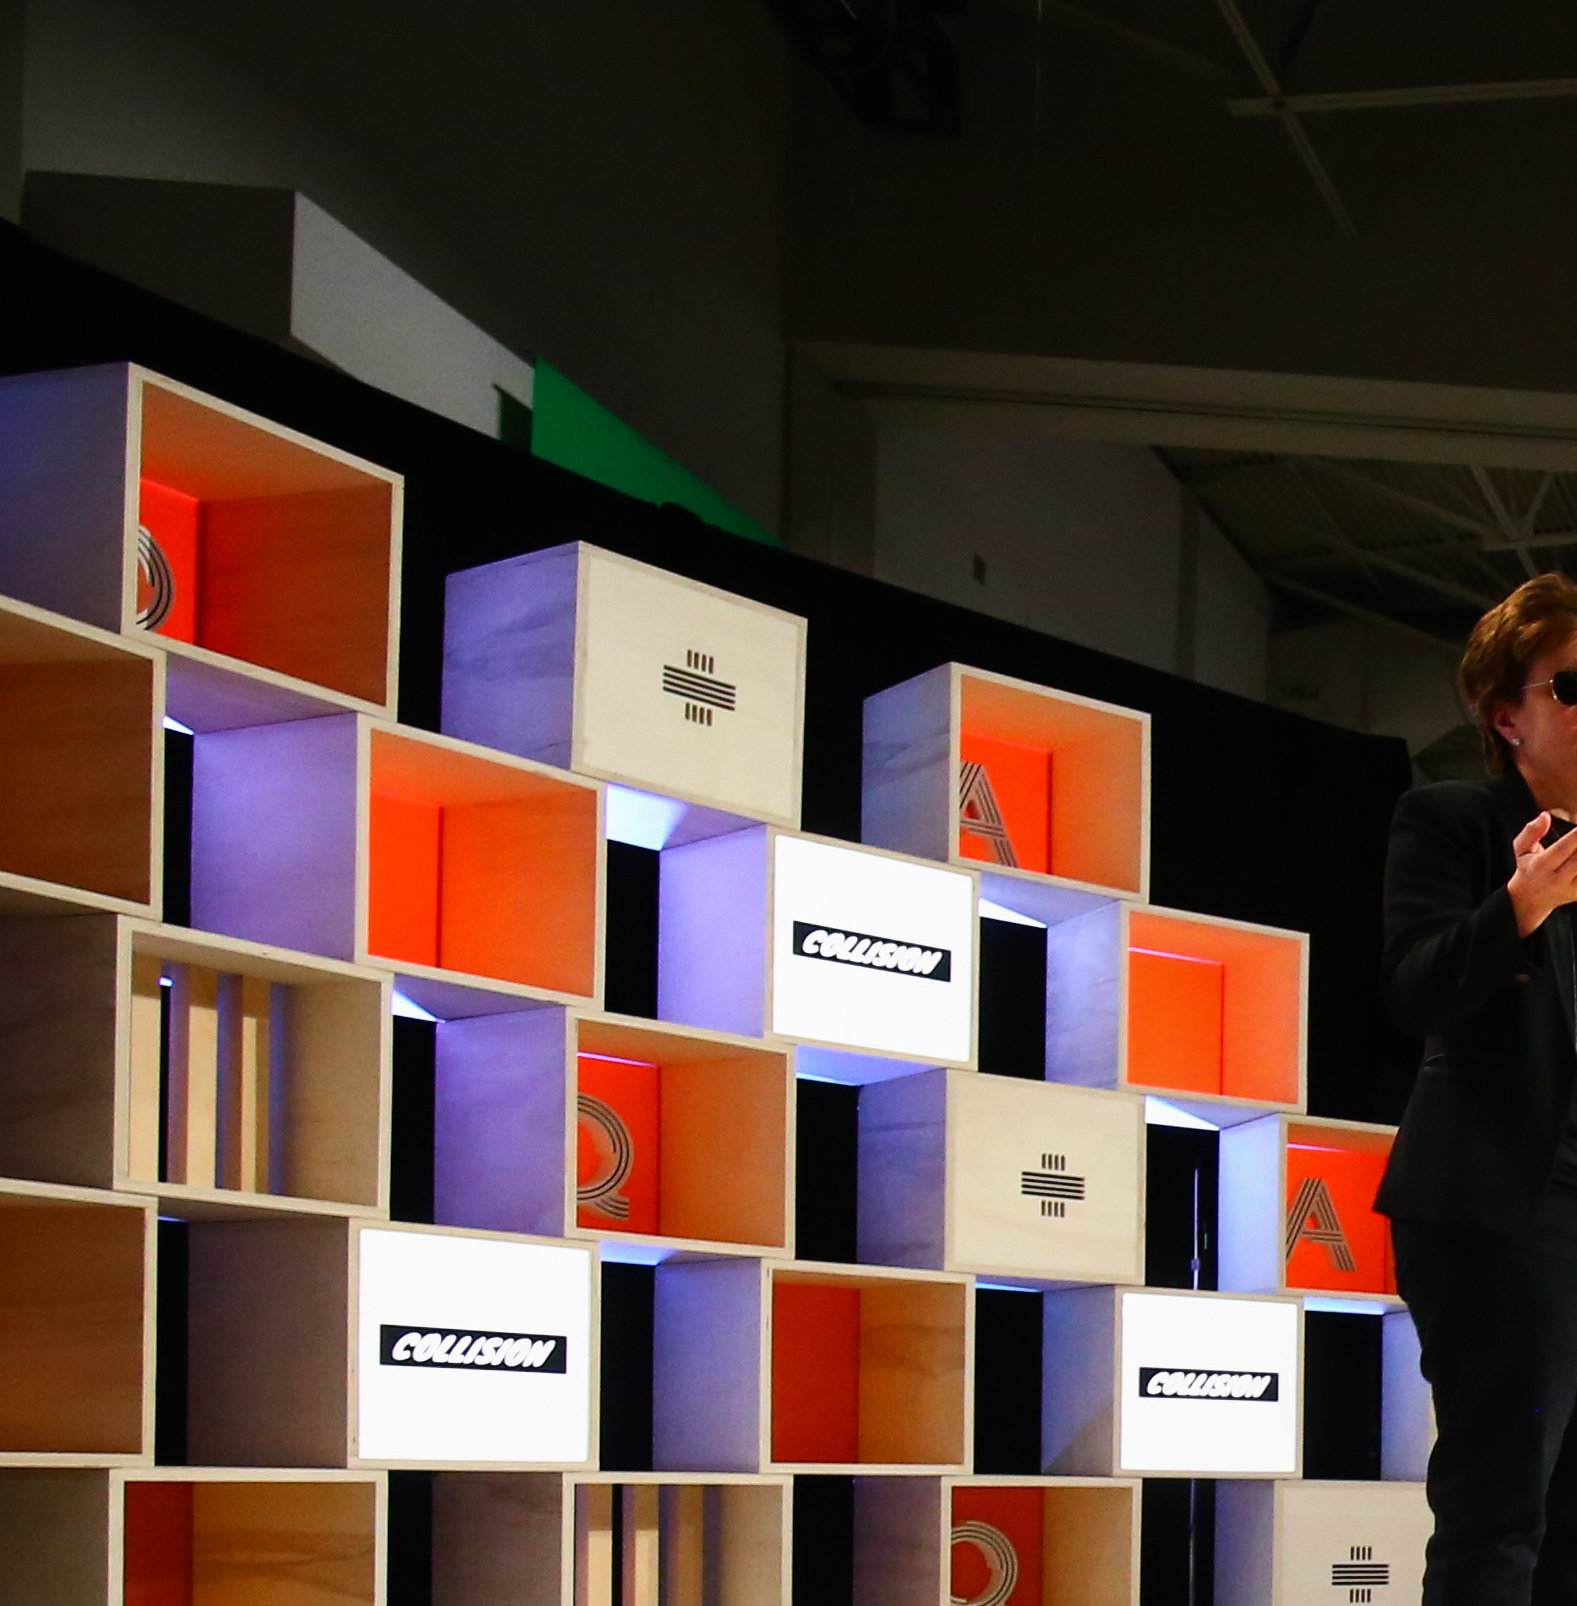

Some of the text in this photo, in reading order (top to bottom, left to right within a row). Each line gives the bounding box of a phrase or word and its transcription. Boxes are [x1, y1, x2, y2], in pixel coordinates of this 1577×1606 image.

[801, 929, 943, 975] COLLISION
[1285, 1177, 1357, 1271] A
[391, 1331, 556, 1368] COLLISION
[1146, 1371, 1272, 1398] COLLISION
